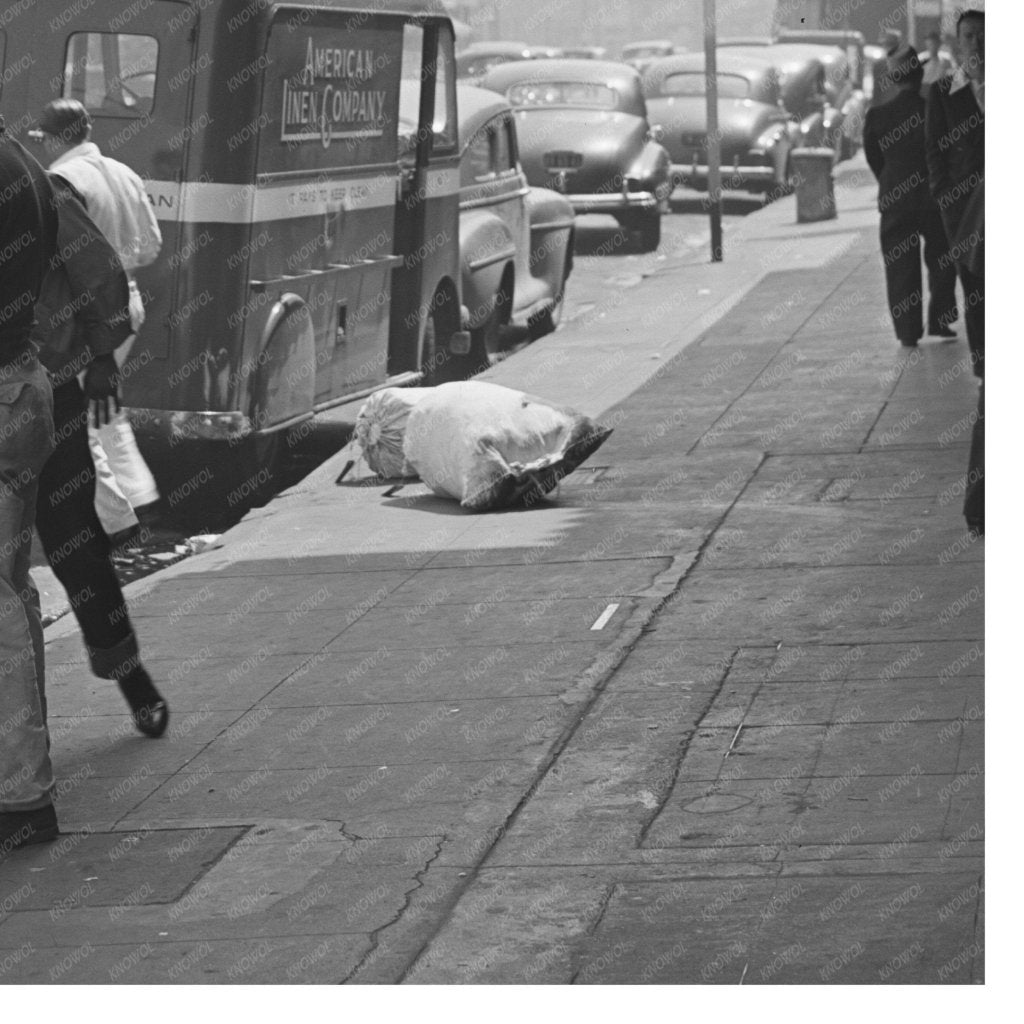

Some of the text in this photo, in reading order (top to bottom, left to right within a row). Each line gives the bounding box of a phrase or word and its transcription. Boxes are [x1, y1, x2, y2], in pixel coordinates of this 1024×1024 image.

[302, 36, 374, 86] AMERICAN
[280, 78, 386, 149] LINEN COMPANY
